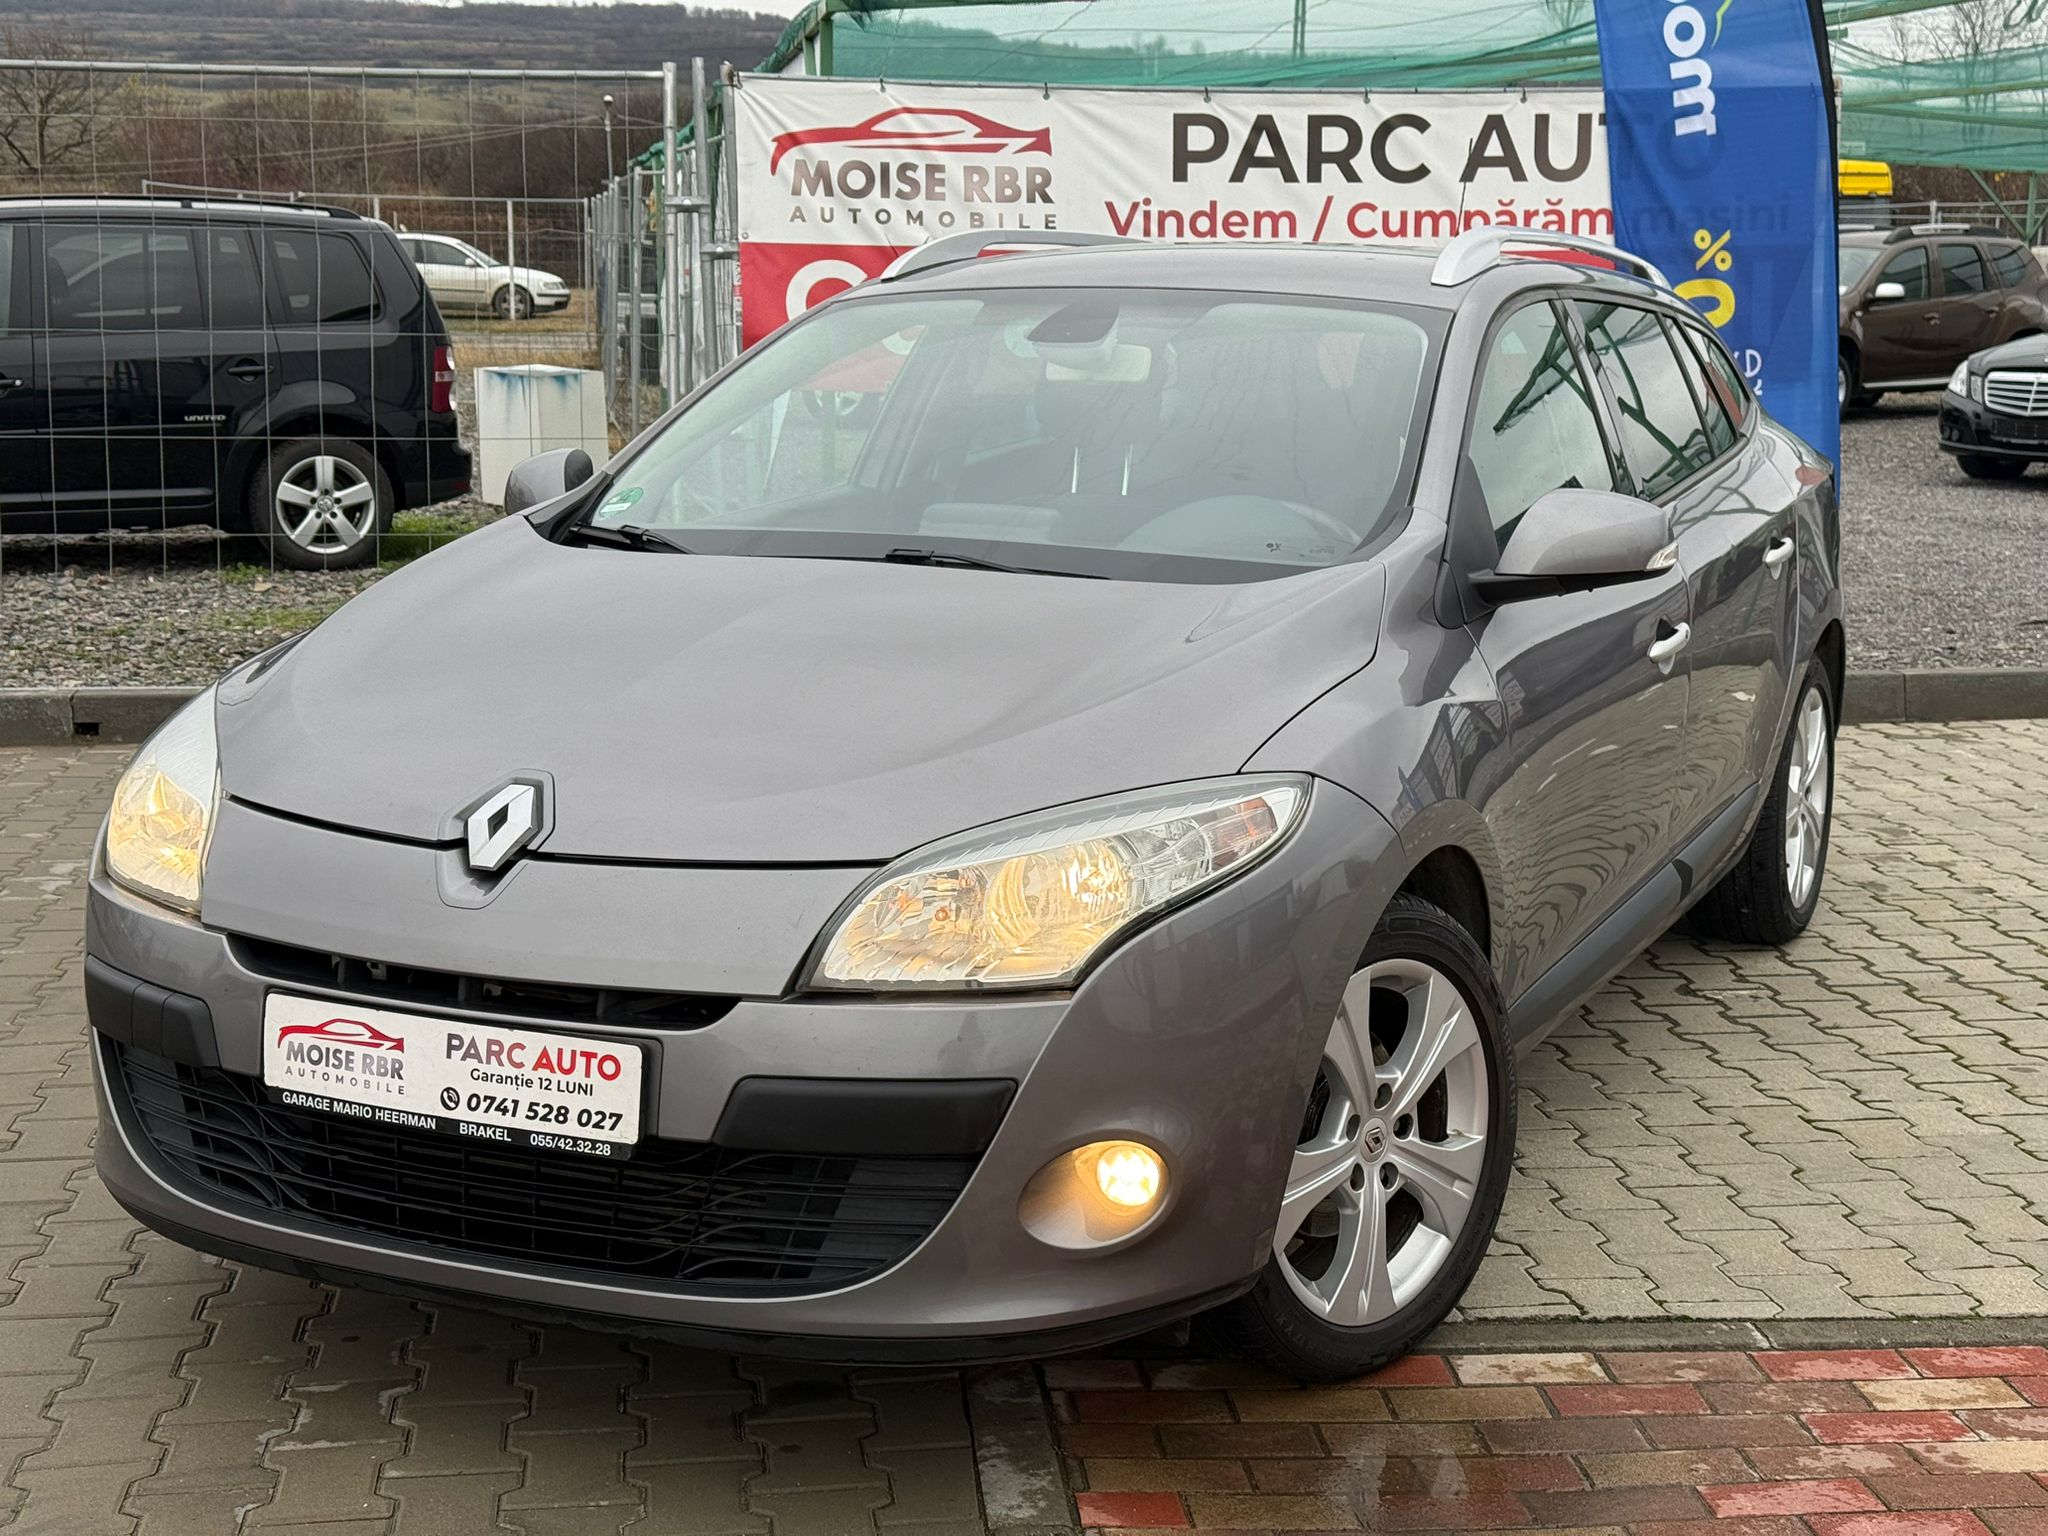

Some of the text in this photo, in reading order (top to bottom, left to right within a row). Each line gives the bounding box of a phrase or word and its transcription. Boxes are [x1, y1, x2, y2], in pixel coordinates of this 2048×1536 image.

[1172, 112, 1432, 184] PARC
[791, 158, 1055, 204] MOISE RBR
[789, 205, 1057, 230] AUTOMOBILE
[1104, 197, 1297, 238] Vindem
[184, 414, 226, 422] UNITED
[286, 1041, 404, 1081] MOISE RBR
[445, 1032, 622, 1081] PARC AUTO
[285, 1065, 405, 1096] AUTOMOBILE
[537, 1077, 552, 1091] 12
[557, 1080, 594, 1096] LUNI
[282, 1091, 612, 1156] GARAGE MARIO HEERMAN BRAKEL 055/42.32.28
[466, 1093, 623, 1131] 0741 528 027
